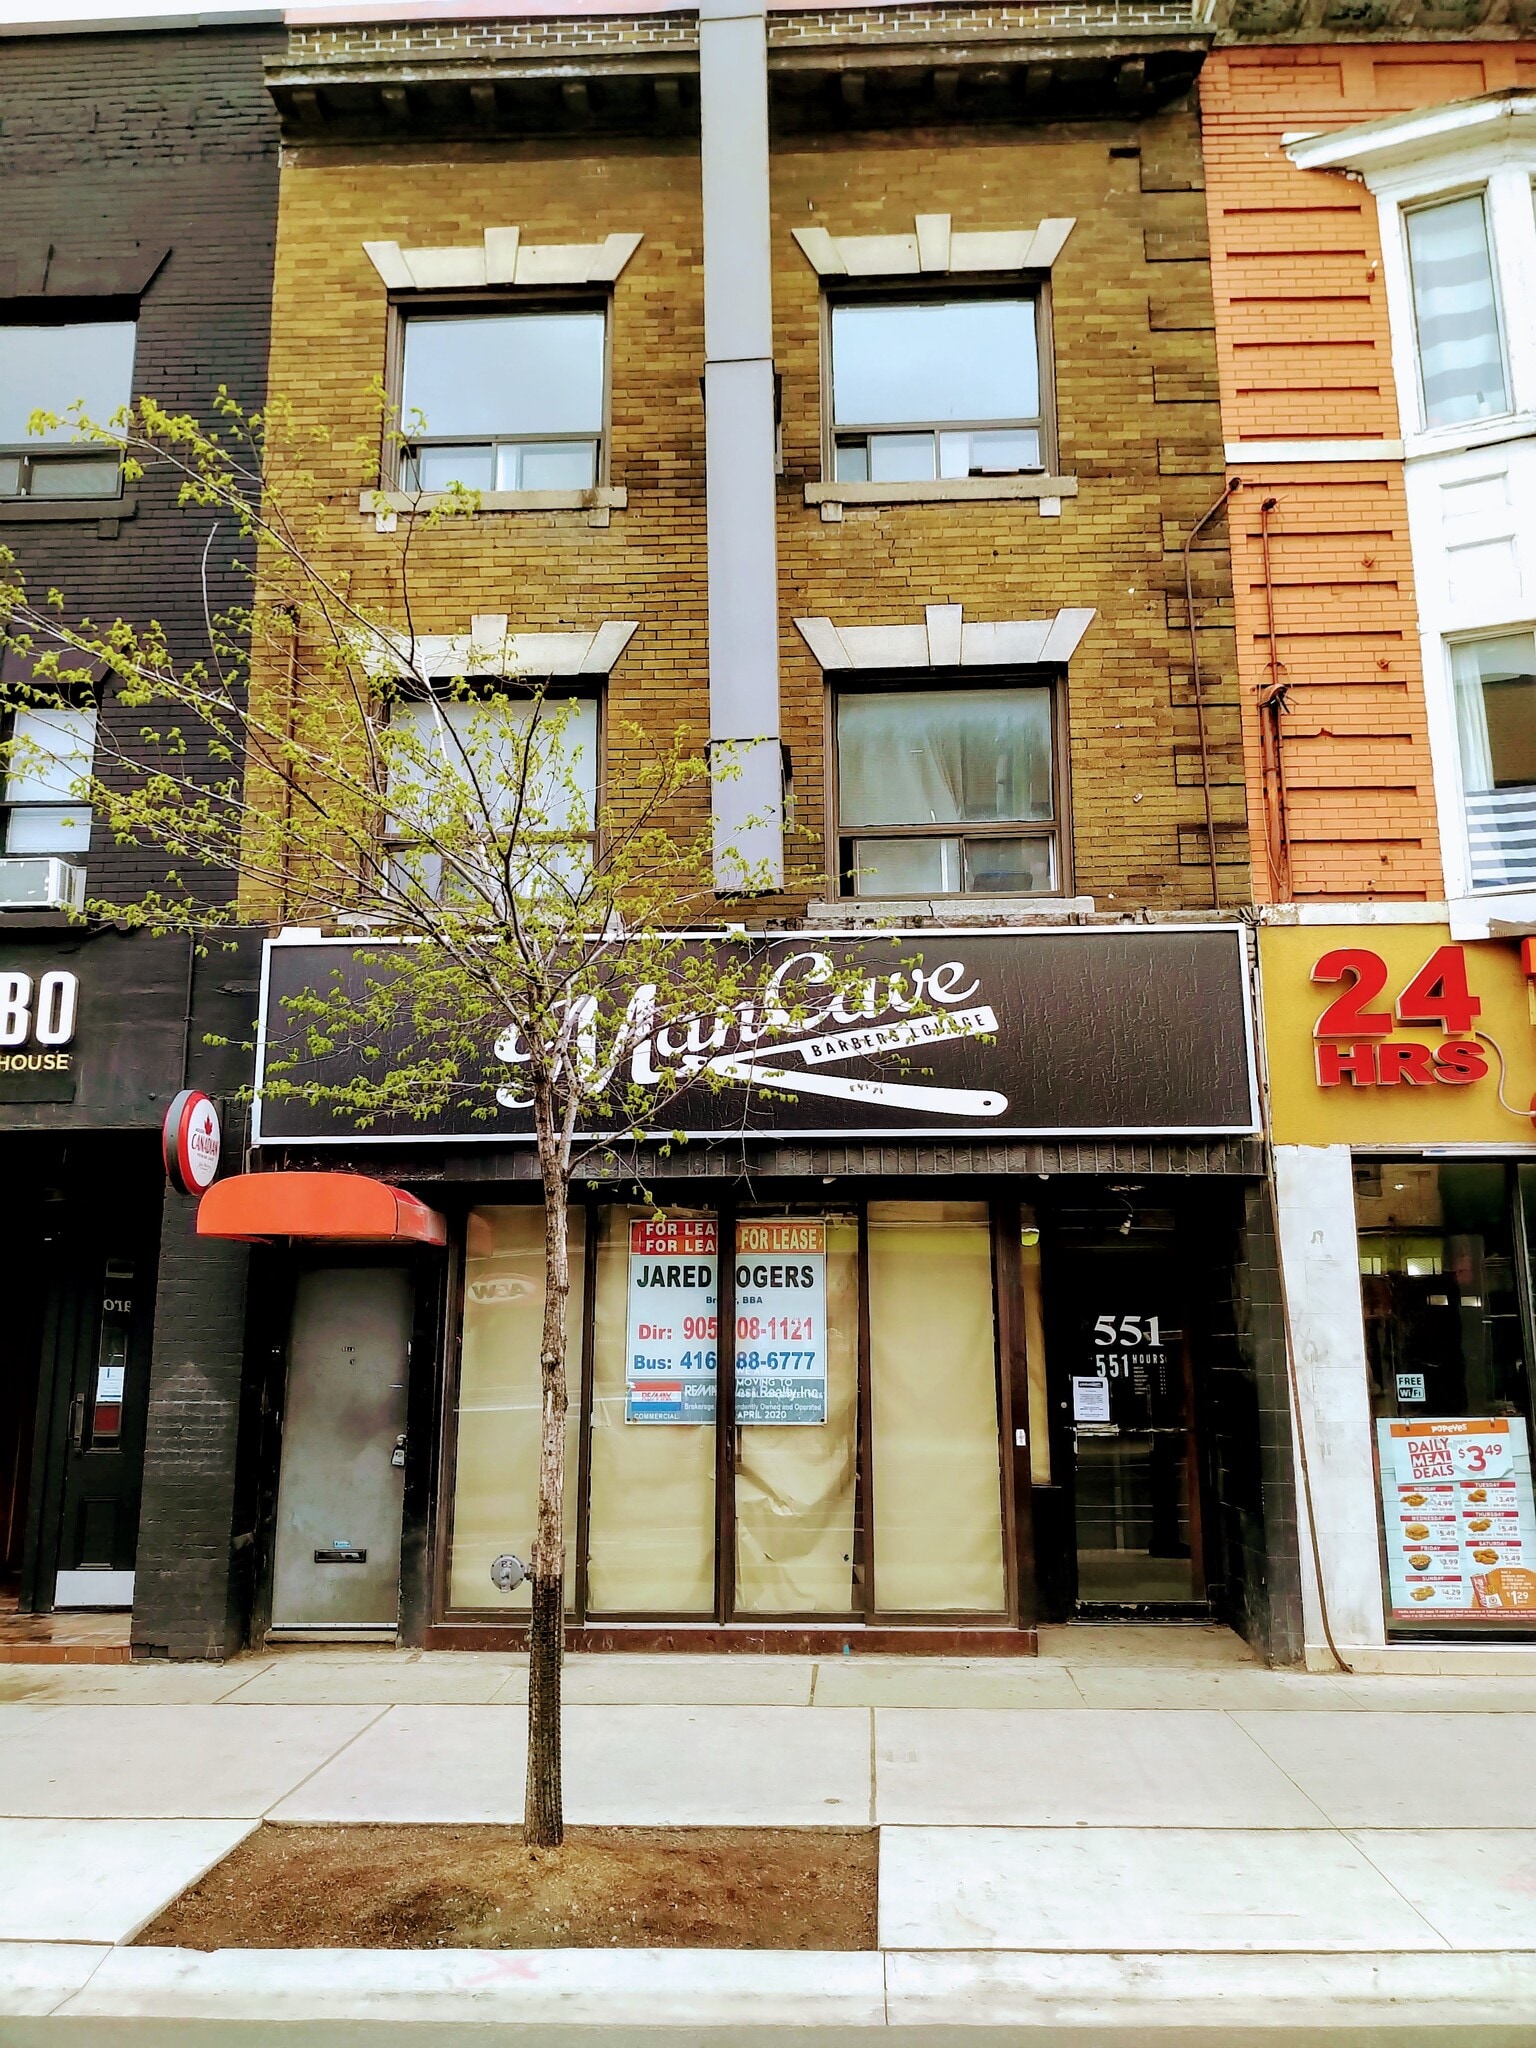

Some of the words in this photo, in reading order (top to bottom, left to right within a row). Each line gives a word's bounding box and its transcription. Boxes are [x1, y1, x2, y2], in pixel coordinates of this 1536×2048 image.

[1310, 945, 1481, 1038] 24
[1315, 1040, 1489, 1087] HRS
[191, 1133, 219, 1157] CANADIAN
[646, 1223, 678, 1236] FOR
[684, 1223, 715, 1236] LEA
[646, 1239, 678, 1252] FOR
[684, 1239, 715, 1252] LEA
[741, 1229, 769, 1250] FOR
[773, 1229, 817, 1250] LEASE
[637, 1265, 712, 1288] JARED
[736, 1265, 814, 1288] OGERS
[742, 1296, 763, 1304] BBA
[638, 1324, 672, 1340] Dir:
[1094, 1316, 1164, 1346] 551
[634, 1354, 672, 1370] Bus:
[1095, 1354, 1129, 1378] 551
[1132, 1354, 1165, 1364] HOURS
[736, 1378, 775, 1387] MOVING
[780, 1378, 793, 1387] TO
[1398, 1376, 1422, 1386] FREE
[641, 1392, 672, 1401] RE/MAX
[684, 1384, 717, 1397] RE/MA
[736, 1410, 761, 1419] APRIL
[764, 1410, 787, 1419] 2020
[1408, 1438, 1449, 1454] DAILY
[1411, 1450, 1453, 1468] MEAL
[1413, 1465, 1455, 1480] DEALS
